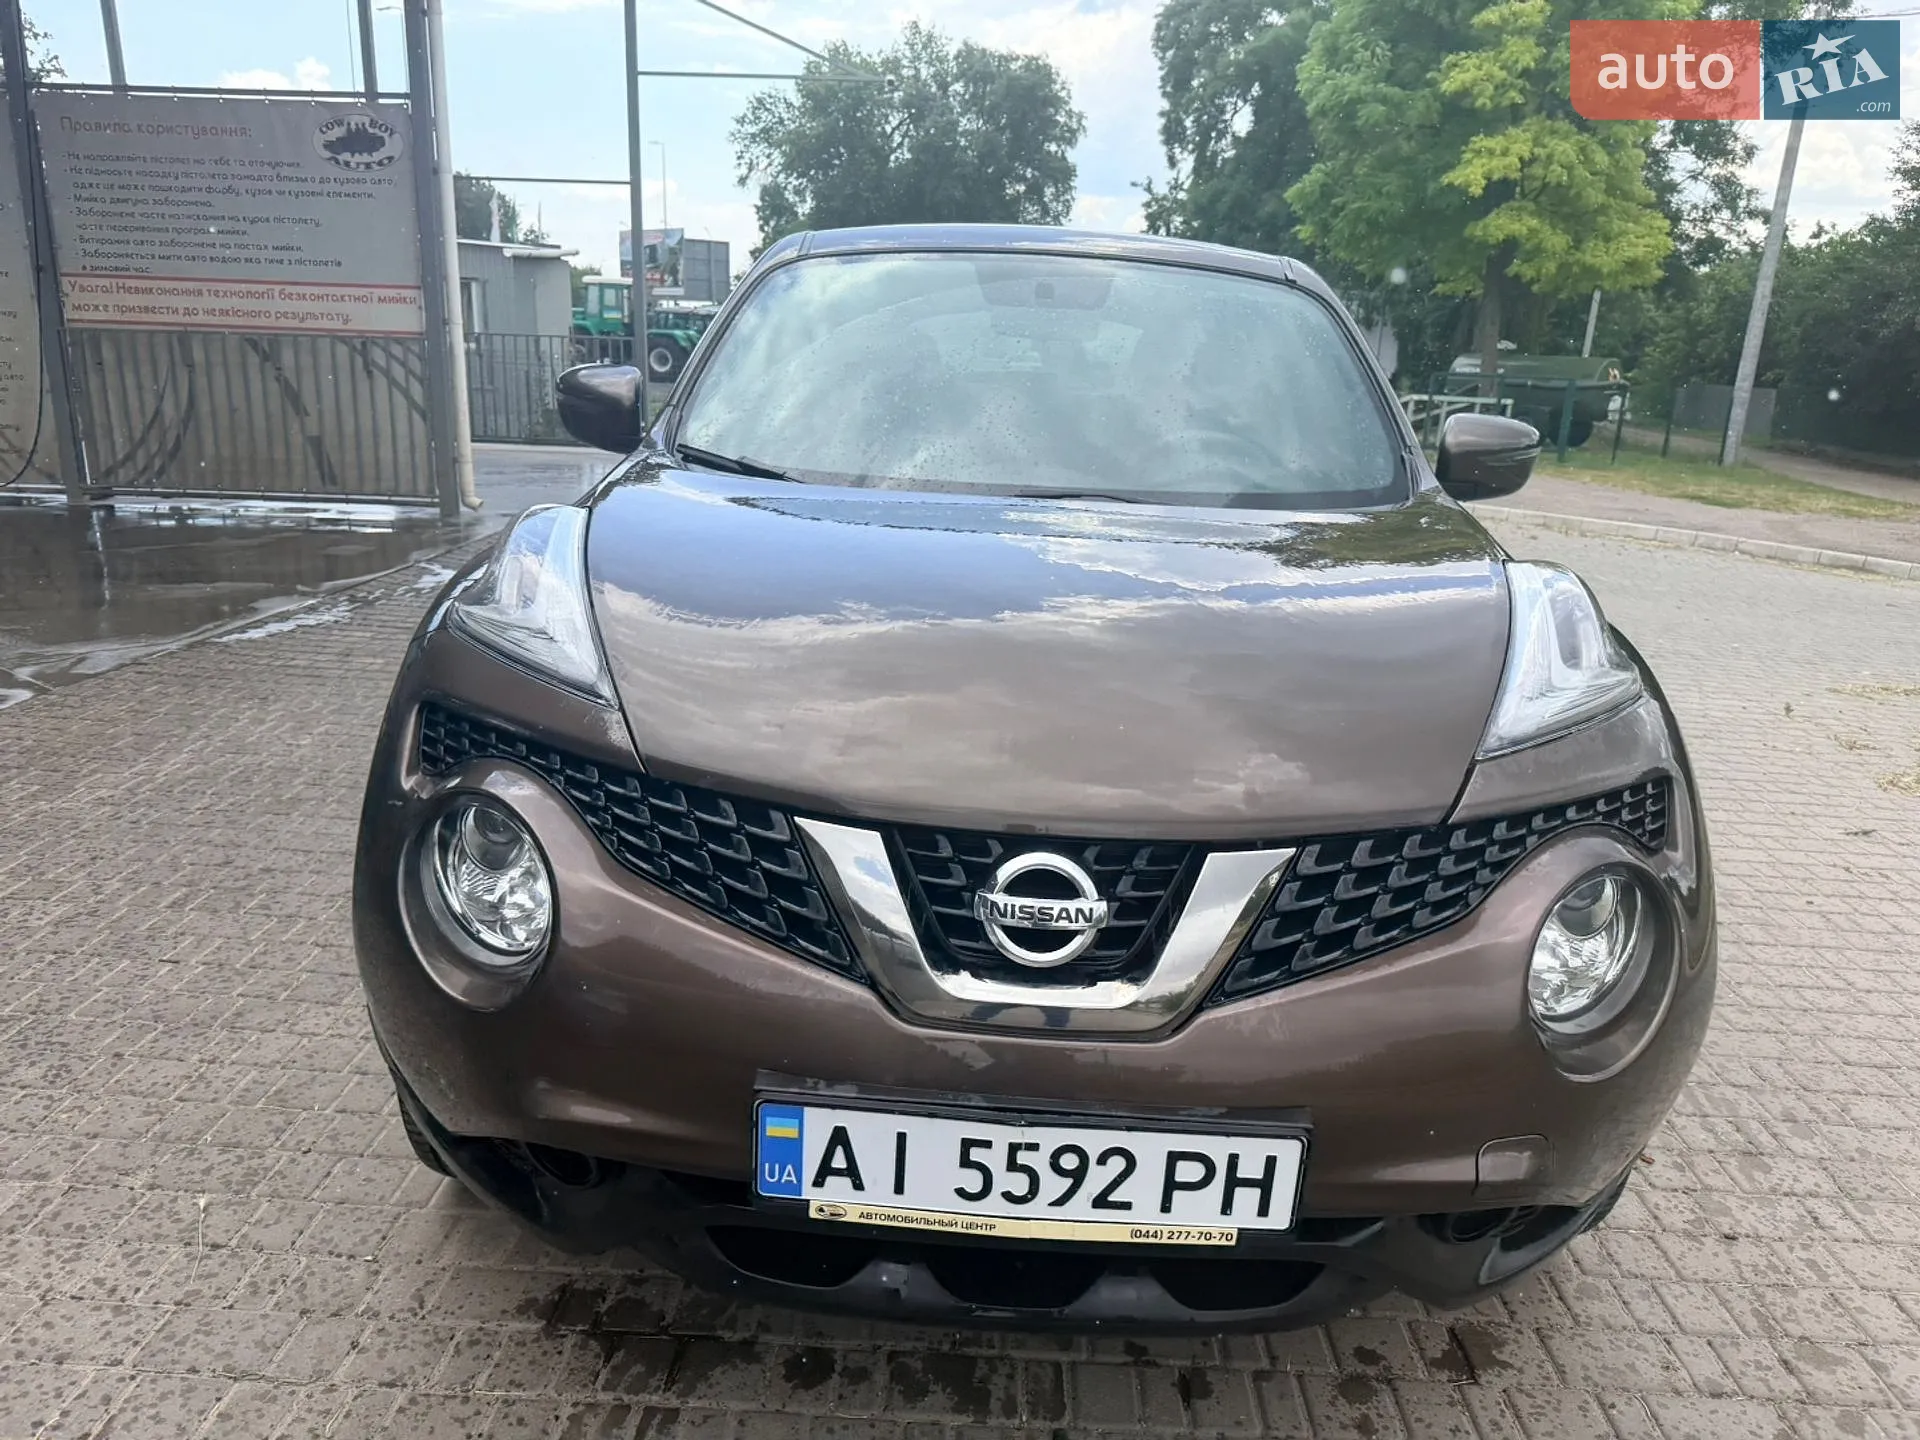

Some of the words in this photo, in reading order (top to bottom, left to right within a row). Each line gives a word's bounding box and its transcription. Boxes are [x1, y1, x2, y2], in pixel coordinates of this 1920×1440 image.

[60, 116, 133, 134] Правила
[136, 121, 252, 140] користування:
[319, 119, 345, 134] COW
[369, 119, 394, 138] BOY
[68, 279, 113, 293] Увага!
[116, 282, 204, 297] Невиконання
[207, 287, 276, 300] технології
[279, 288, 375, 305] безконтактної
[377, 292, 418, 306] мийки
[72, 302, 110, 313] може
[113, 303, 180, 316] призвести
[182, 306, 200, 318] до
[202, 306, 272, 319] неякісного
[275, 309, 353, 325] результату.
[989, 901, 1094, 924] NISSAN
[764, 1163, 798, 1185] UA
[811, 1125, 908, 1196] AI
[953, 1137, 1138, 1213] 5592
[1160, 1150, 1279, 1218] PH
[858, 1210, 959, 1229] АВТОМОБИЛЬНЫЙ
[961, 1220, 997, 1233] ЦЕНТР
[1130, 1228, 1163, 1241] (044)
[1167, 1230, 1234, 1242] 277-70-70
